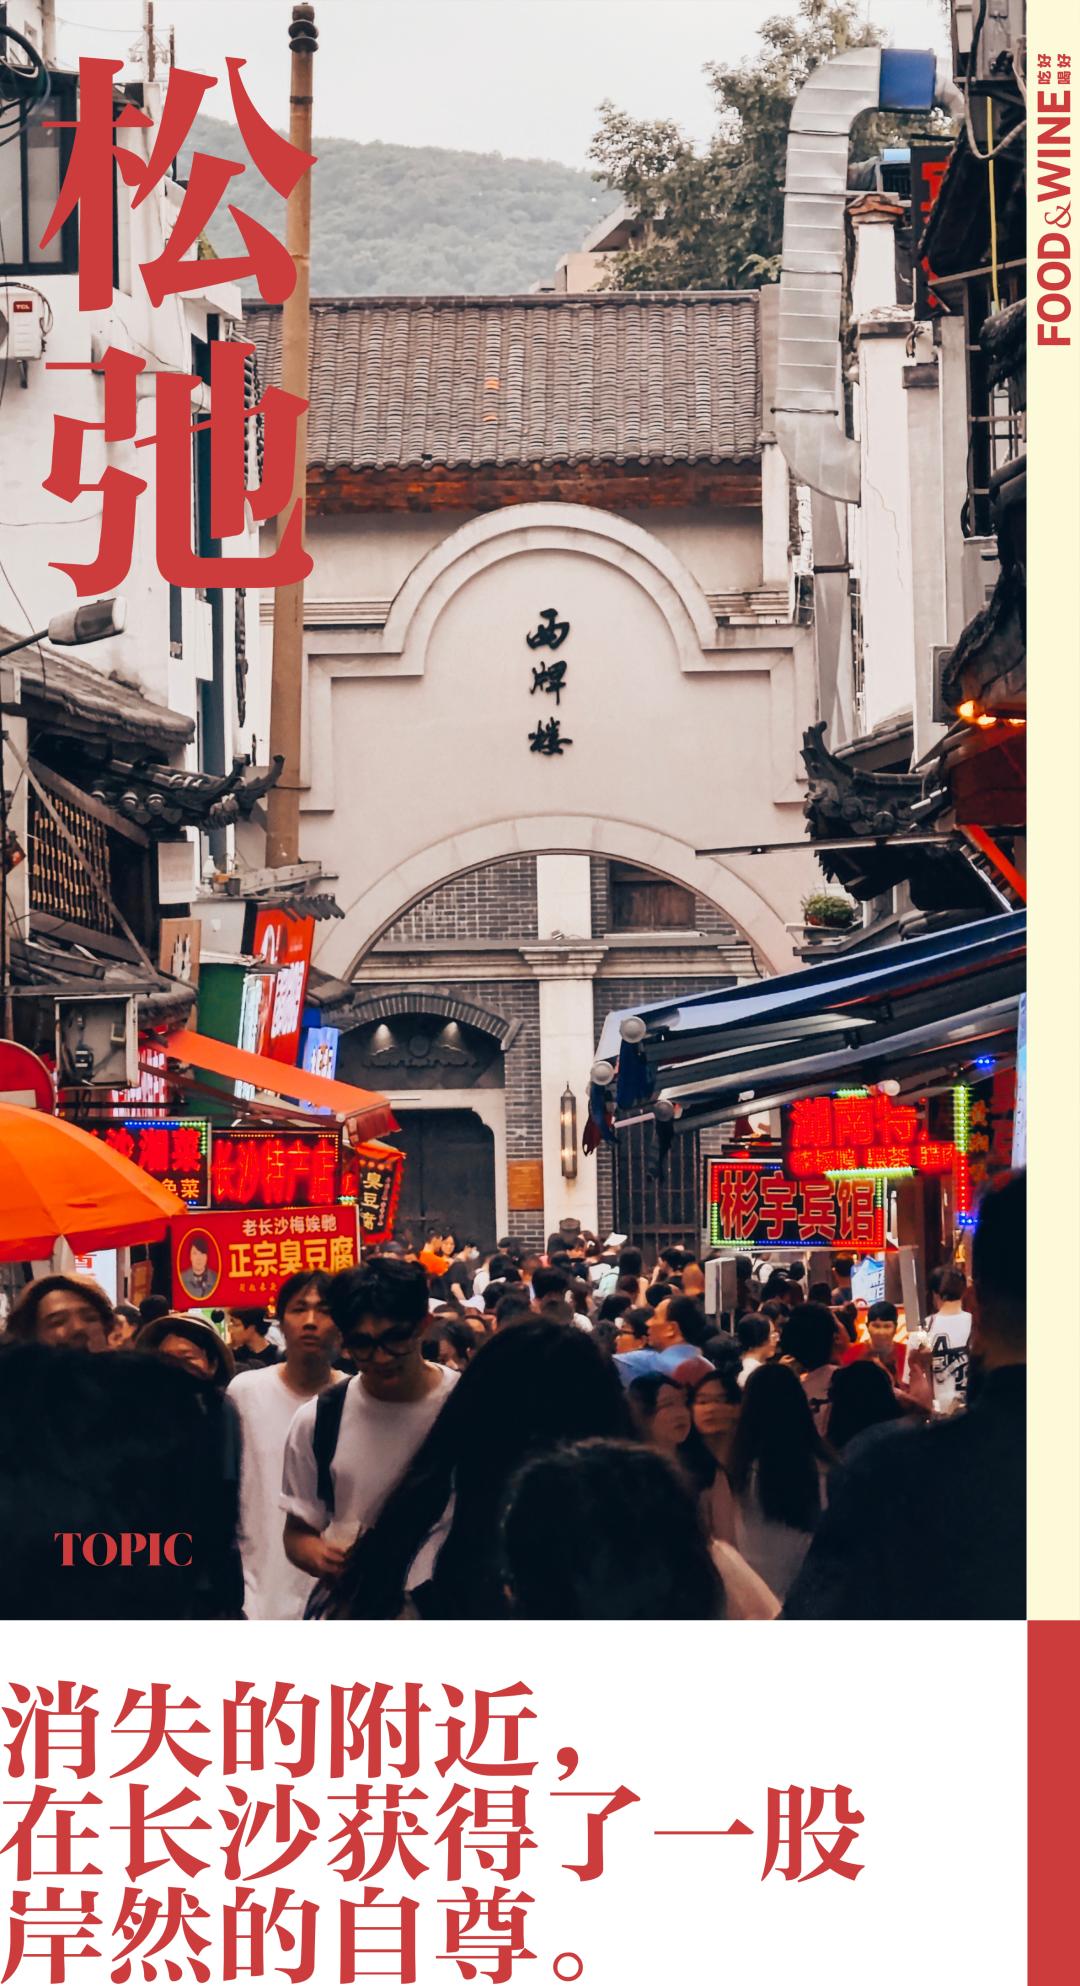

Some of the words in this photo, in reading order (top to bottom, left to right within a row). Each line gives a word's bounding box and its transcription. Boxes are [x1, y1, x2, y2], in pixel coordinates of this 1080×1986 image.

[527, 609, 572, 756] 西牌楼
[720, 1170, 876, 1241] 彬宇宾馆
[228, 1235, 354, 1279] 正宗臭豆腐
